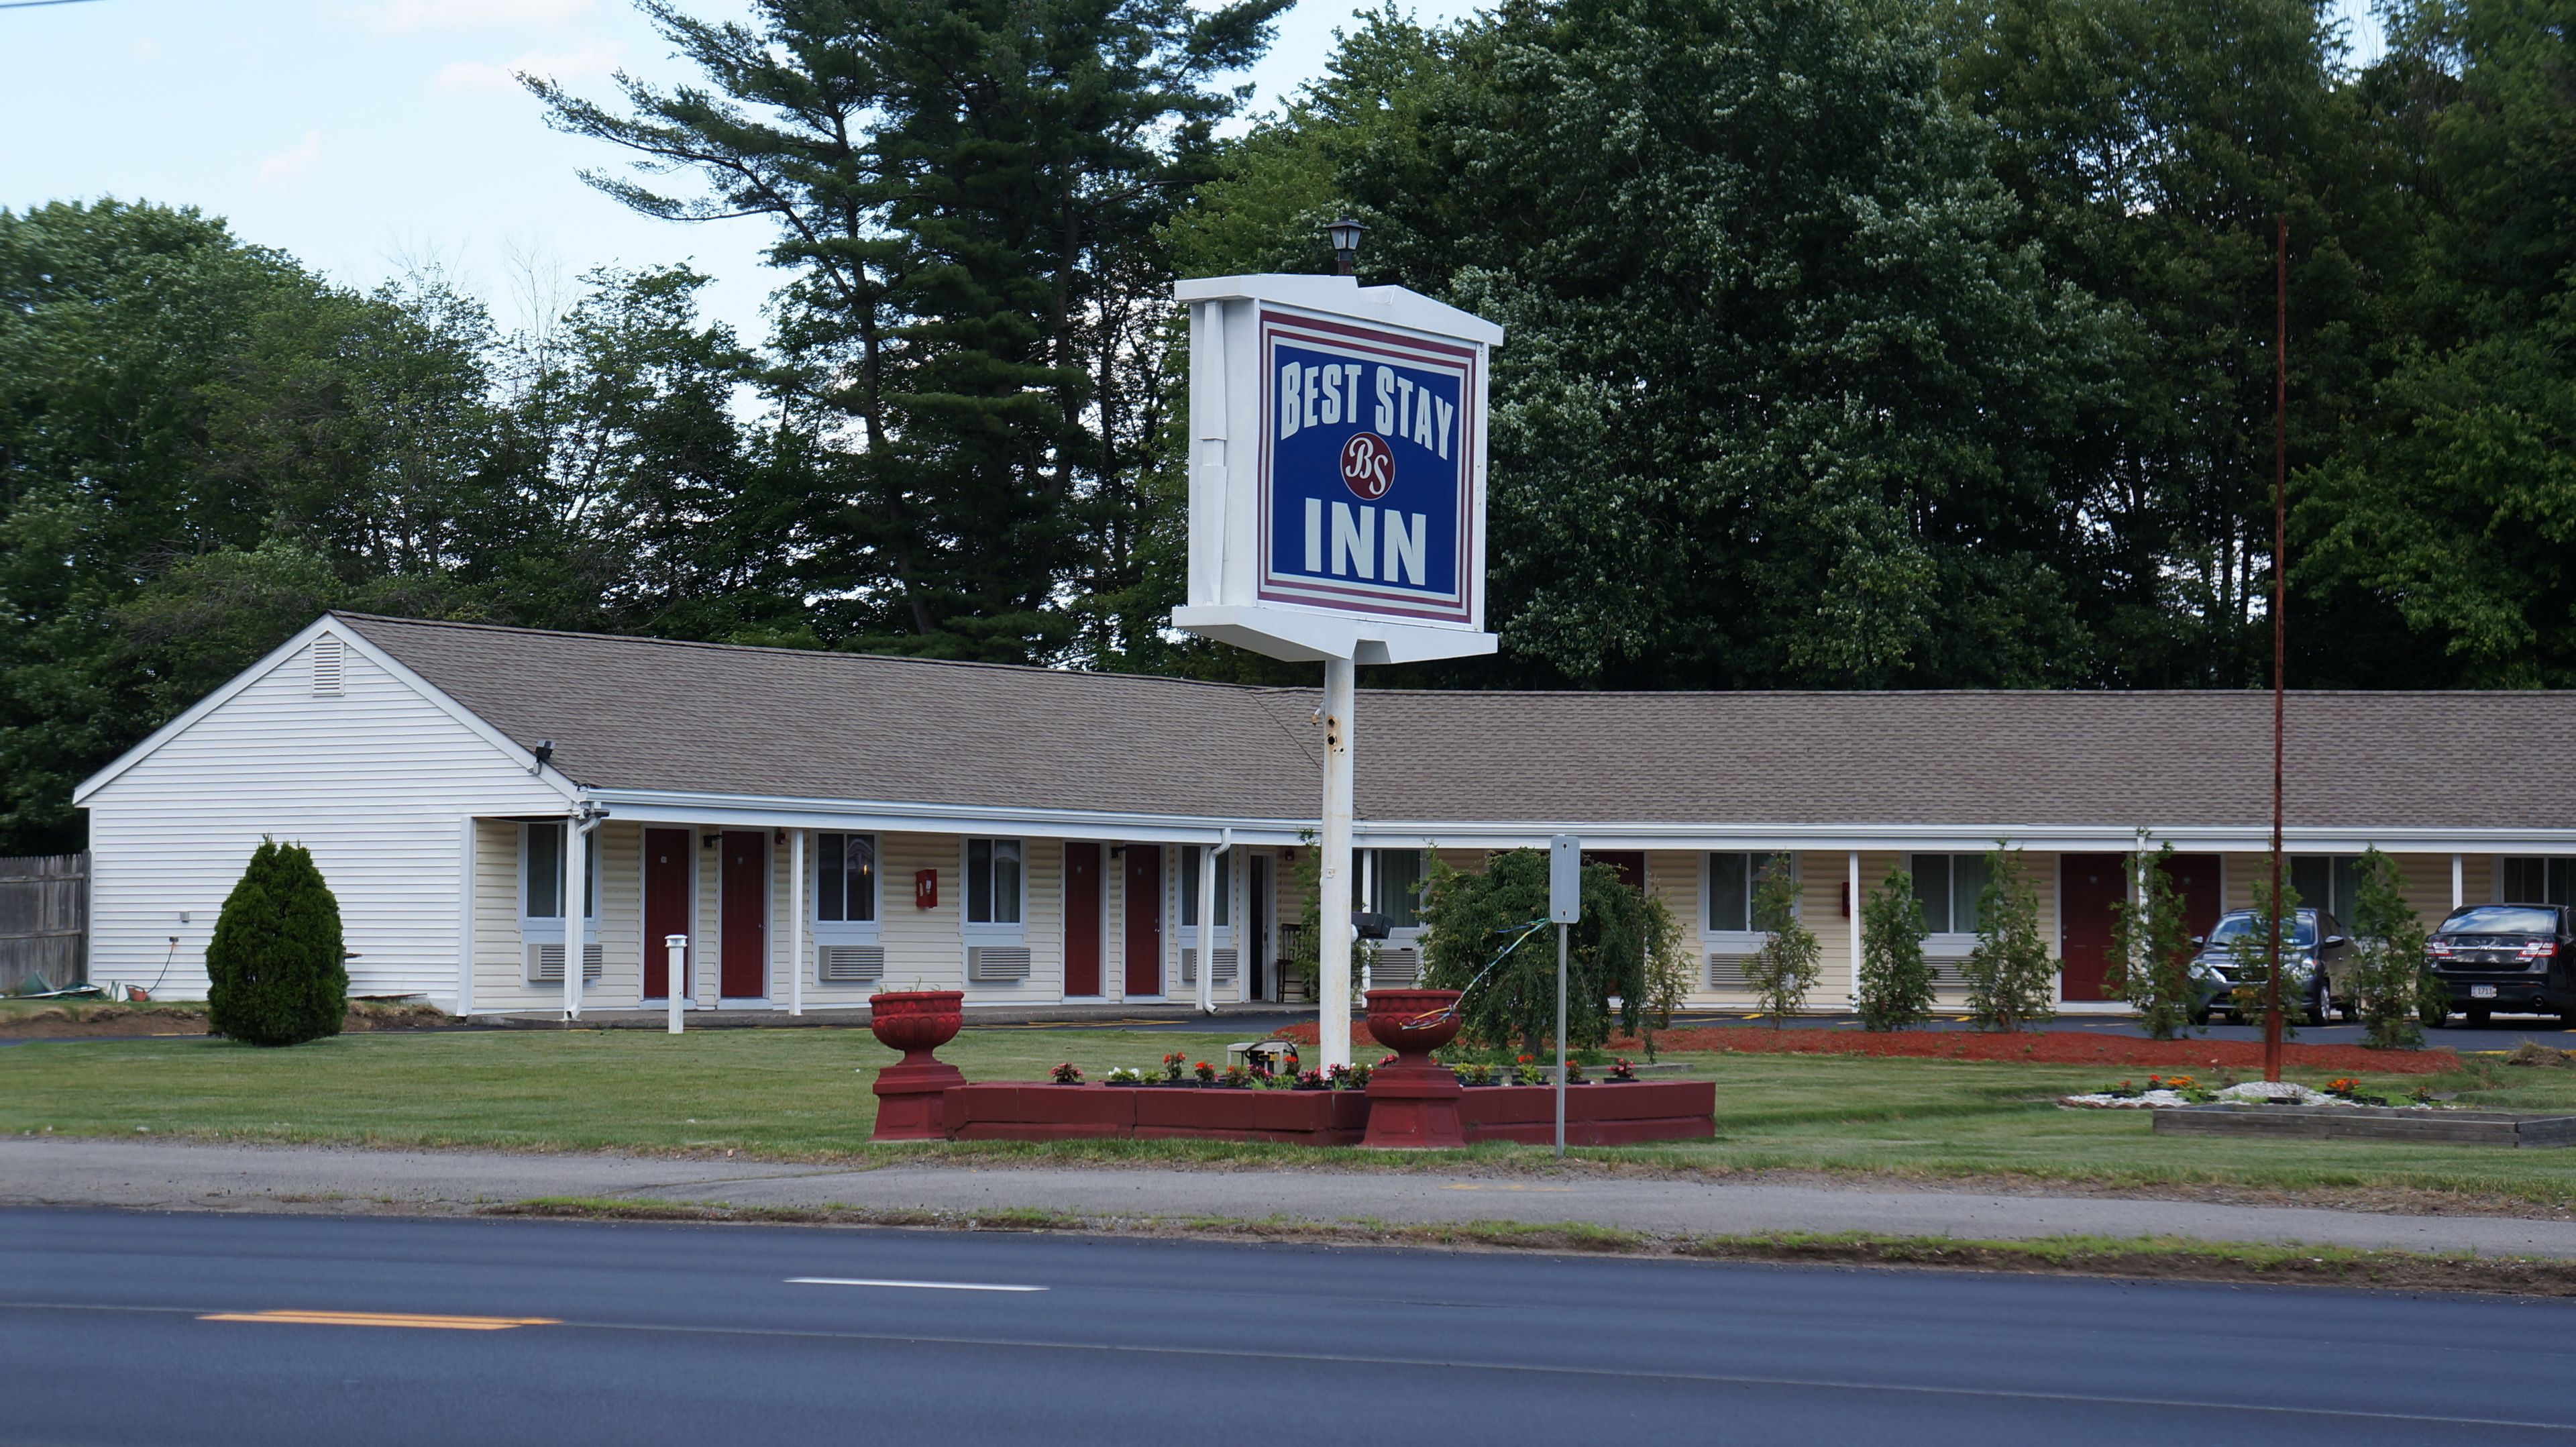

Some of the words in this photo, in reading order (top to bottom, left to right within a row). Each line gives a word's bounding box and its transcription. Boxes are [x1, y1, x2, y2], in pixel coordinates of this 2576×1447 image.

[1281, 362, 1362, 441] BEST
[1375, 366, 1454, 461] STAY
[1305, 497, 1426, 586] INN
